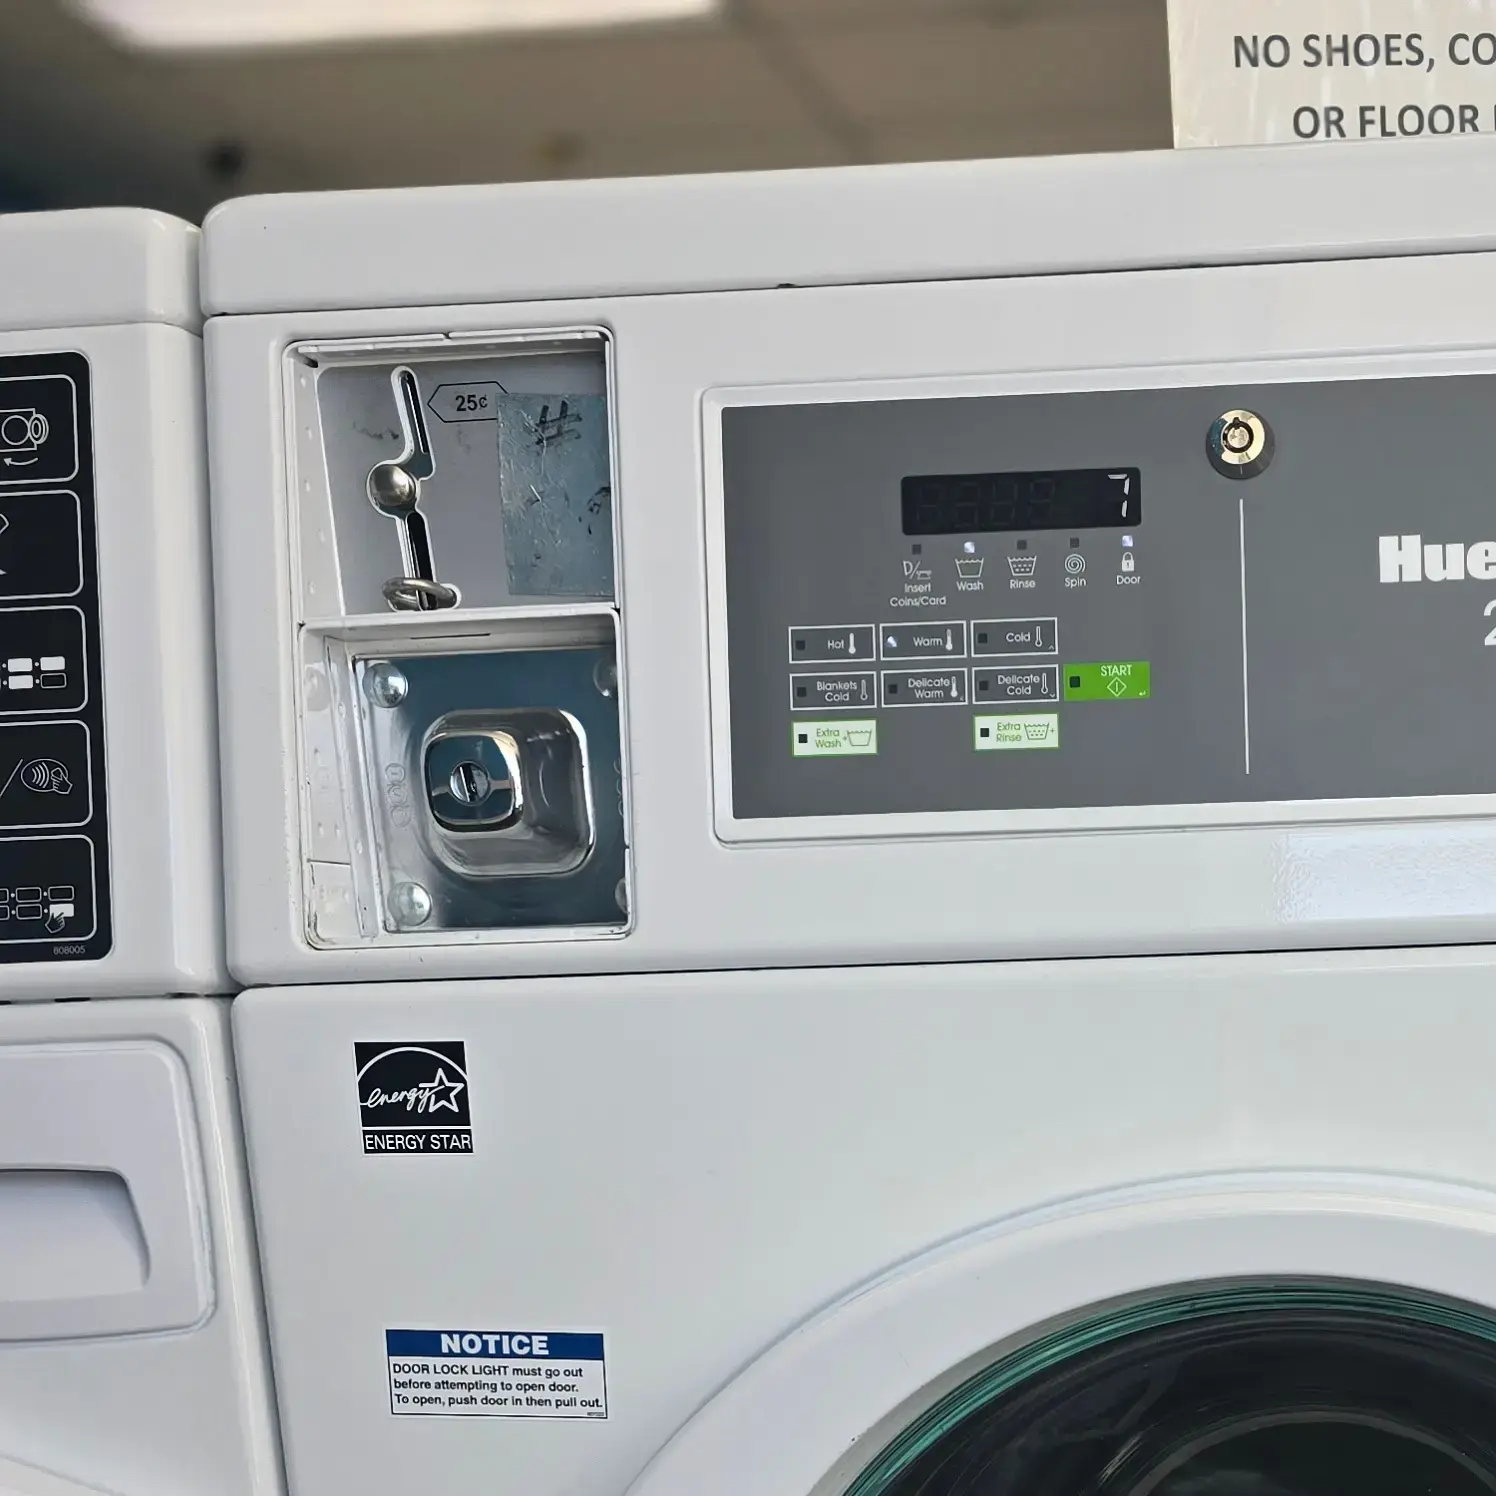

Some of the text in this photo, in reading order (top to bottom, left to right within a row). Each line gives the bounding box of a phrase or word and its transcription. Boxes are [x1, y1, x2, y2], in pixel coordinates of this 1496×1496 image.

[1234, 36, 1290, 68] NO
[1302, 34, 1435, 73] SHOES,
[1293, 105, 1345, 139] OR
[1359, 104, 1479, 138] FLOOR
[455, 394, 488, 412] 25¢
[1106, 474, 1130, 518] 7
[956, 580, 984, 591] Wash
[1009, 578, 1036, 590] Rinse
[1064, 576, 1087, 589] Spin
[1116, 574, 1141, 586] Door
[904, 583, 932, 594] Insert
[889, 595, 947, 609] Coins/Card
[913, 636, 943, 648] Warm
[1006, 631, 1031, 644] Cold
[827, 639, 845, 651] Hot
[1100, 664, 1132, 677] START
[908, 677, 950, 688] Delicate
[997, 673, 1040, 685] Delicate
[816, 680, 858, 692] Blankets
[1006, 685, 1032, 696] Cold
[824, 691, 850, 702] Cold
[914, 688, 944, 699] Warm
[815, 727, 840, 738] Extra
[996, 721, 1021, 732] Extra
[814, 738, 842, 749] Wash
[995, 732, 1022, 743] Rinse
[366, 1086, 429, 1114] energy
[365, 1135, 471, 1150] ENERGY STAR
[441, 1334, 549, 1356] NOTICE
[393, 1363, 583, 1380] DOOR LOCK LIGHT must go out
[394, 1379, 579, 1394] before attempting to open door.
[395, 1394, 603, 1409] To open, push door in then pull out.
